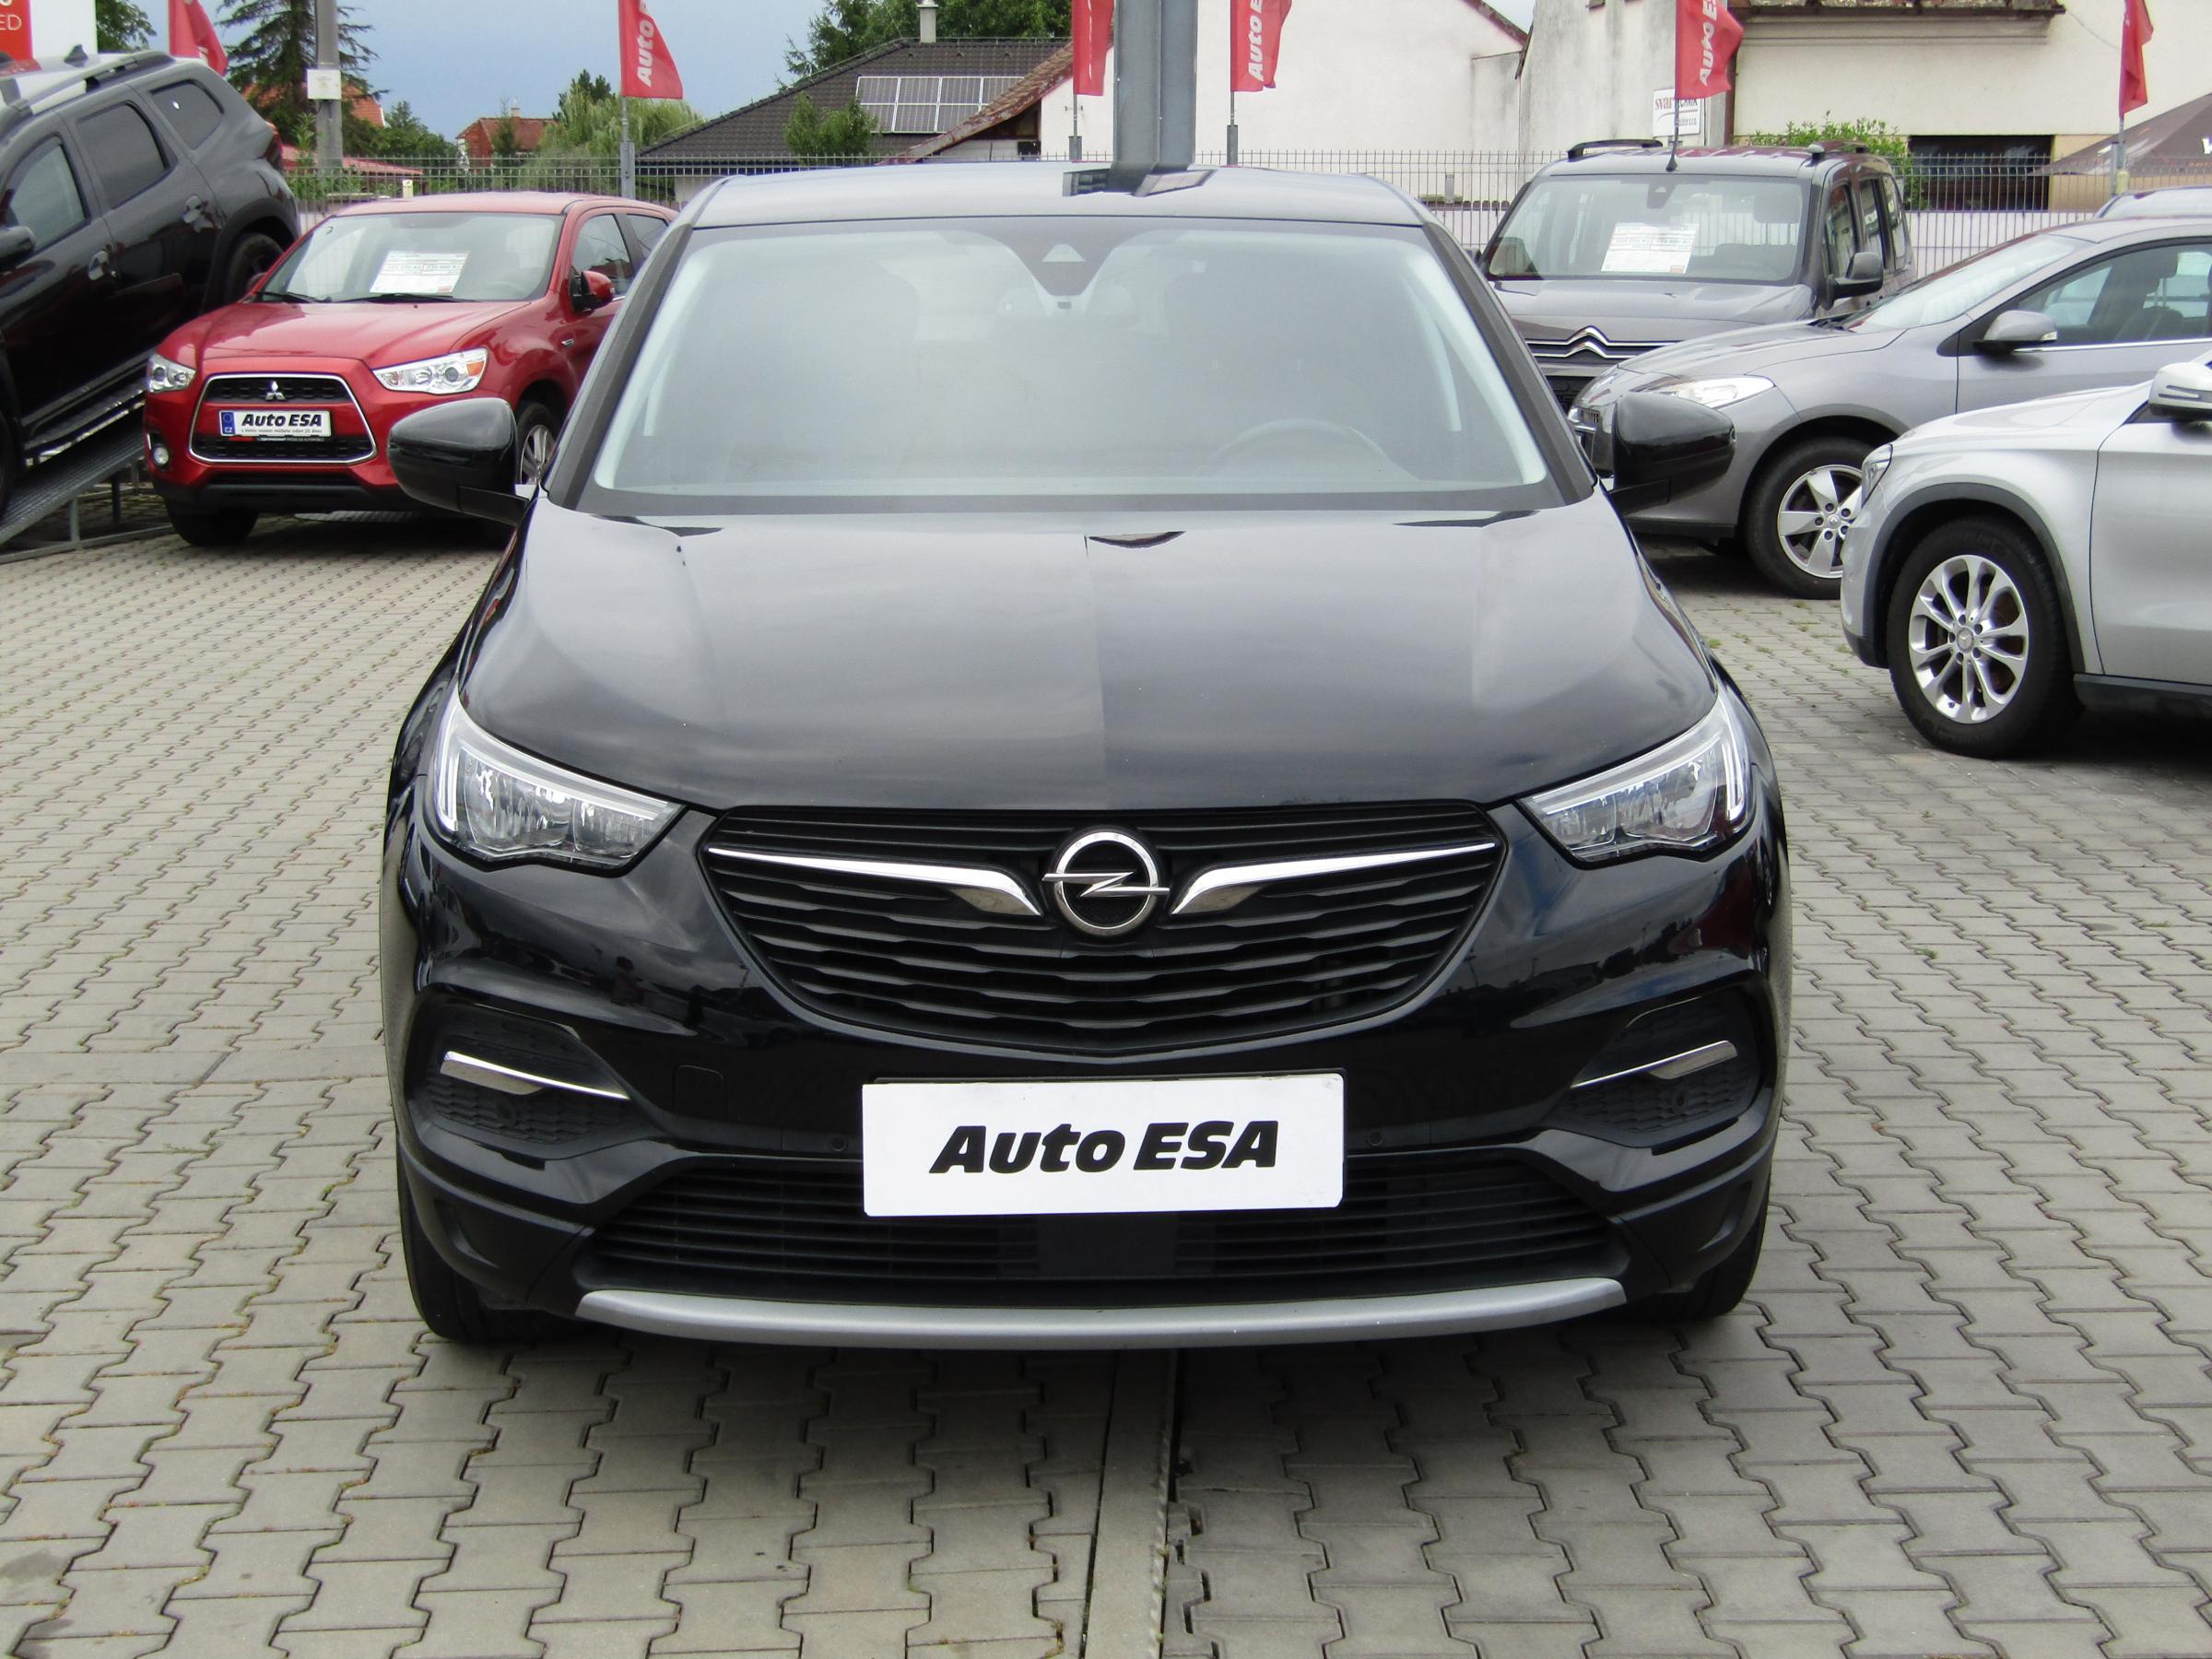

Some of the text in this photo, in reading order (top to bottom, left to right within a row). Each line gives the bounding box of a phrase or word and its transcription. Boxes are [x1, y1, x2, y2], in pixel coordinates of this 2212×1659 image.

[637, 19, 654, 88] Auto
[1248, 15, 1264, 82] Auto
[1699, 22, 1715, 87] Auto
[241, 414, 323, 427] Auto ESA
[929, 1120, 1279, 1174] Auto ESA
